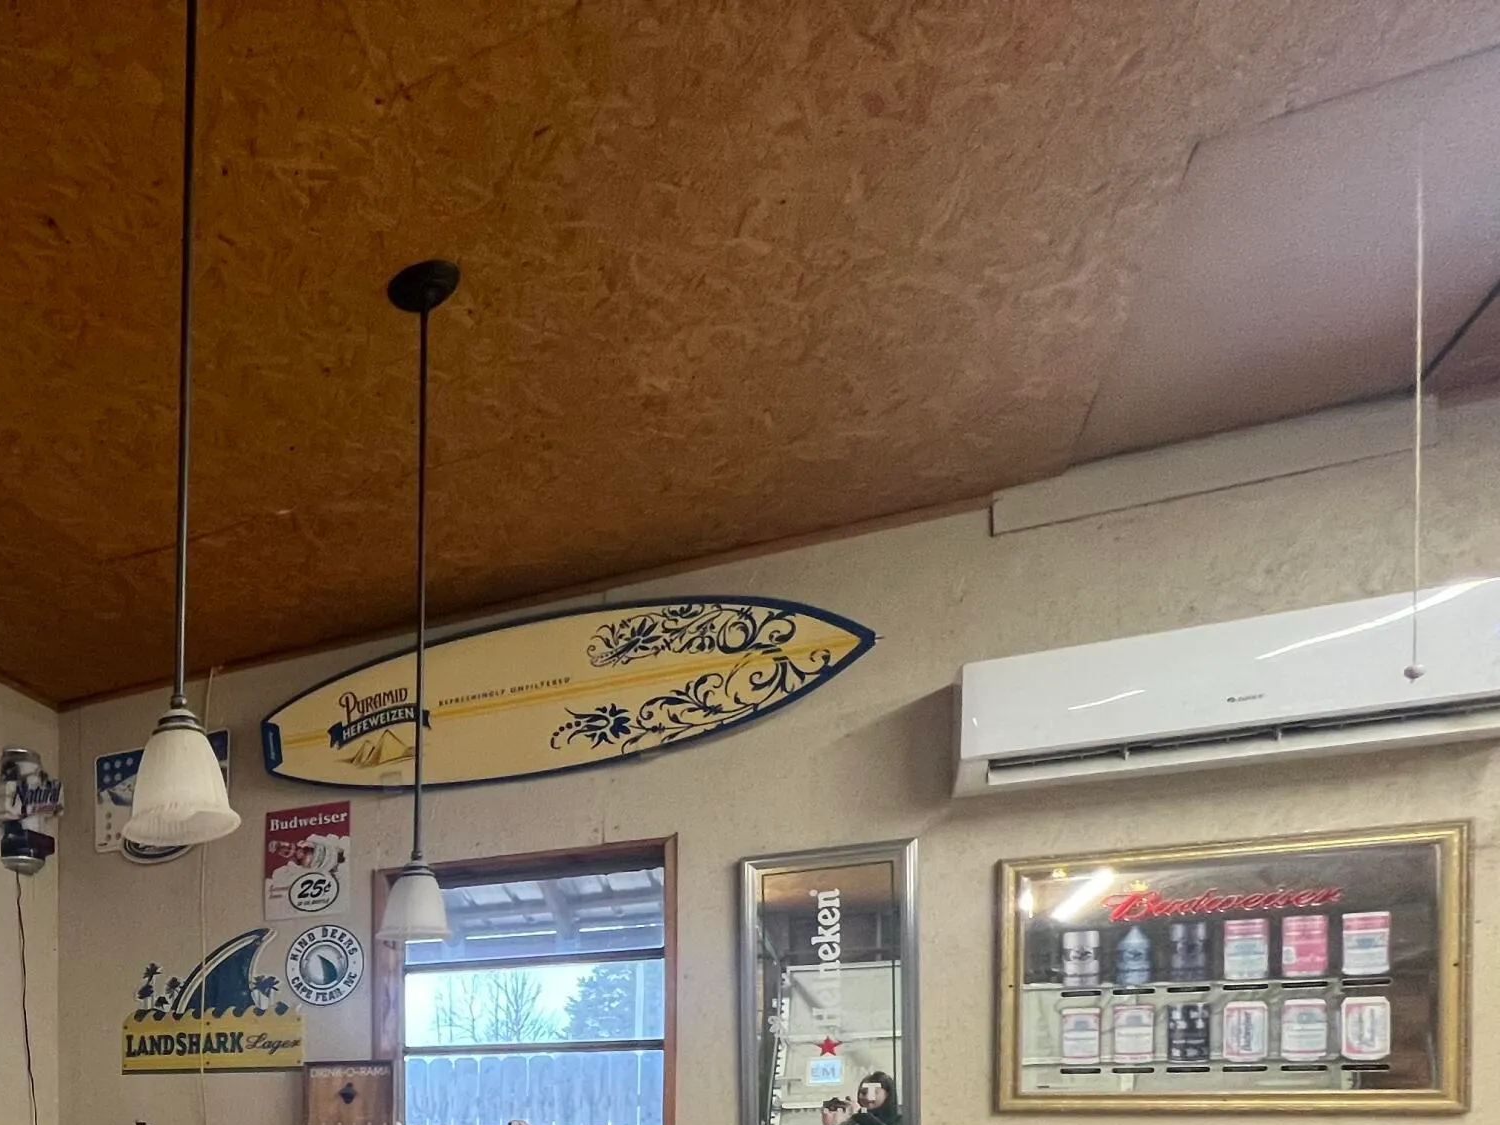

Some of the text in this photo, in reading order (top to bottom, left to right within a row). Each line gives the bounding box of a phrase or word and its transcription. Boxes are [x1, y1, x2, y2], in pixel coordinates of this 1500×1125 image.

[339, 688, 408, 723] PYRAMID
[342, 707, 415, 741] HEFEWEIZEN
[269, 812, 348, 832] Budweiser
[297, 879, 331, 899] 25¢
[1103, 887, 1343, 922] Budweiser
[125, 1031, 300, 1057] LANDSHARK Lager
